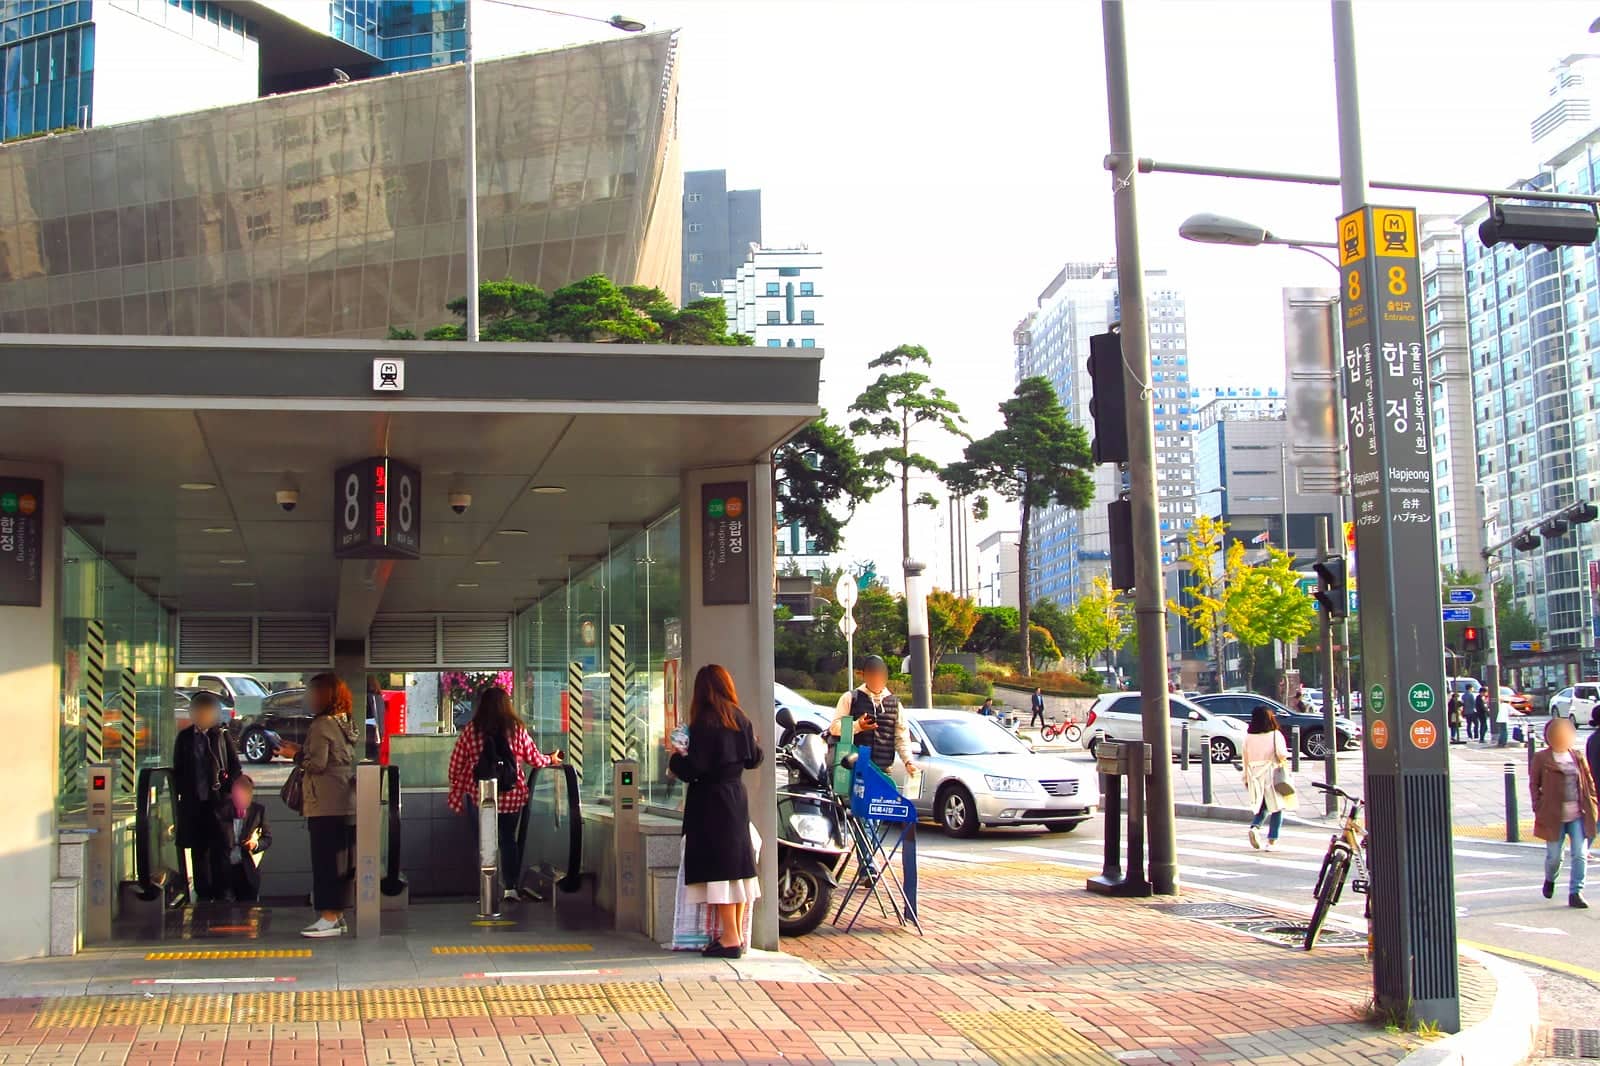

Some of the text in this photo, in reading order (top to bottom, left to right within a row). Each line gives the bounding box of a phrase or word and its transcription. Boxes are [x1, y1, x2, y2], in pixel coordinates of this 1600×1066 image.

[1348, 270, 1360, 300] 8
[1388, 266, 1408, 295] 8
[1346, 346, 1364, 438] 합정
[1382, 342, 1407, 433] 합정
[1389, 467, 1430, 483] Hapjeong
[345, 473, 360, 531] 8
[399, 475, 412, 532] 8
[1402, 498, 1420, 509] 合井
[729, 520, 743, 553] 합정
